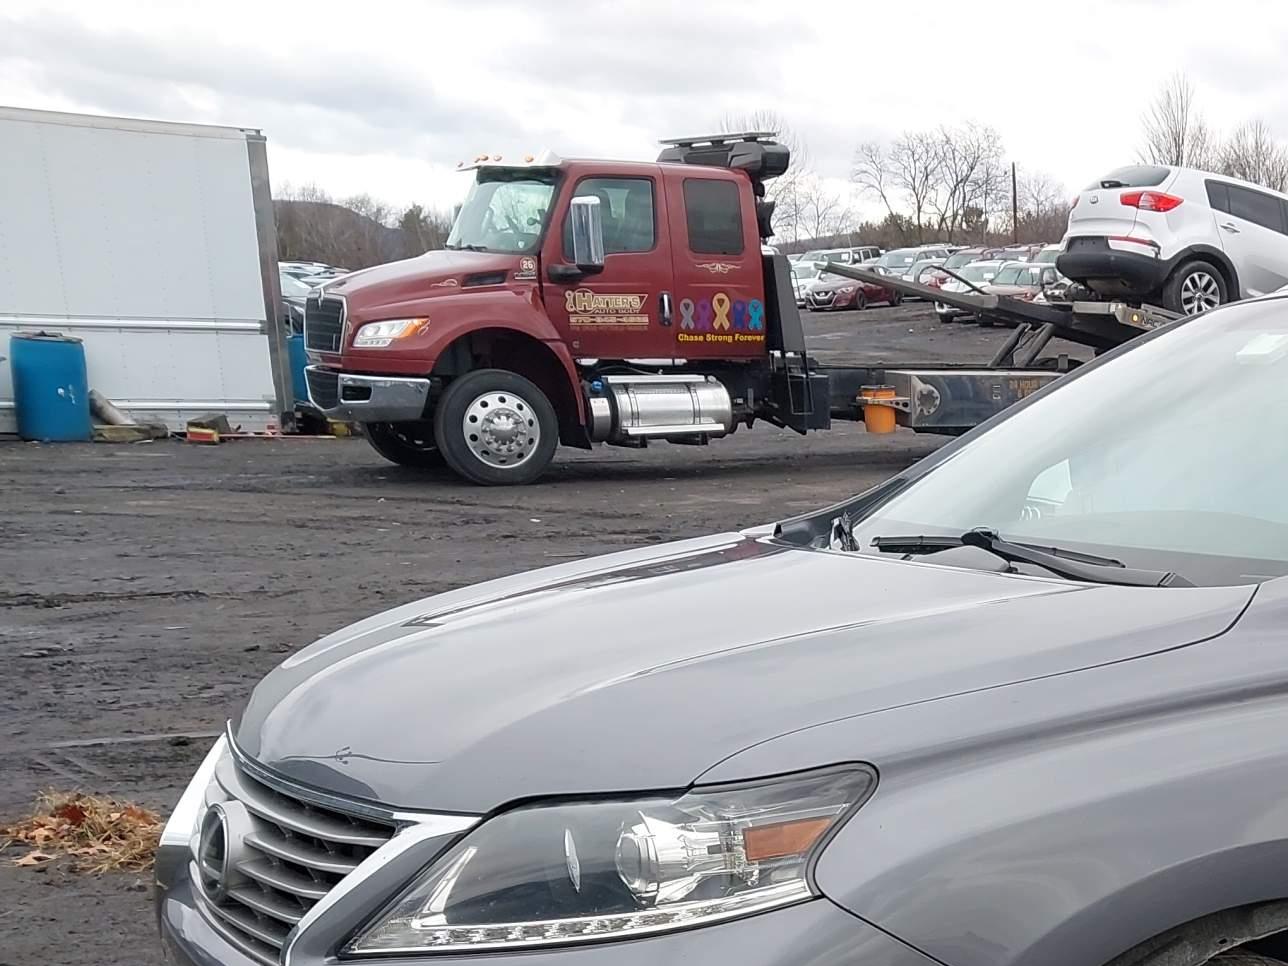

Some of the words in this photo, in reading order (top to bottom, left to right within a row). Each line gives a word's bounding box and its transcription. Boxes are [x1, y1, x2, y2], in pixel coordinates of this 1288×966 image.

[522, 260, 534, 269] 26
[575, 292, 641, 310] HATTER'S
[678, 333, 704, 341] Chase
[706, 333, 733, 343] Strong
[735, 333, 766, 341] Forever
